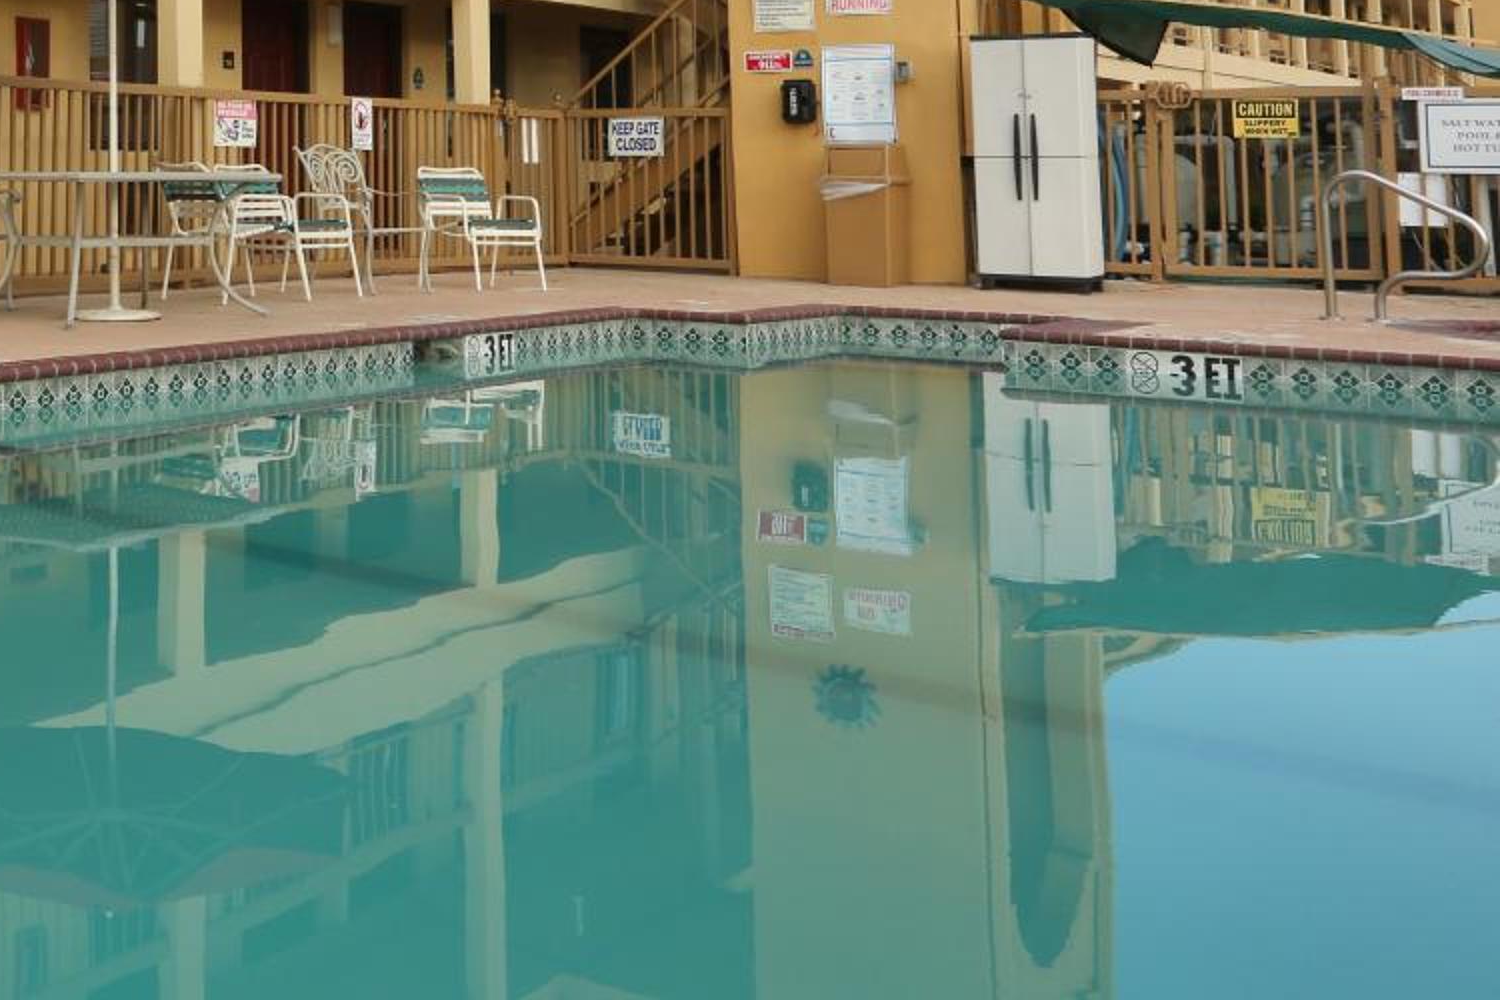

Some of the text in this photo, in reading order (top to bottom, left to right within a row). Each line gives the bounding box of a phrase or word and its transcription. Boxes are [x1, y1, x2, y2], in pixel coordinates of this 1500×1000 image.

[1239, 103, 1293, 116] CAUTION
[612, 121, 659, 135] KEEP GATE
[1243, 119, 1286, 127] SLIPPERY
[1244, 127, 1288, 135] WHEN WET
[1457, 131, 1490, 139] POOL
[616, 137, 657, 151] CLOSED
[1453, 143, 1479, 152] HOT
[1170, 355, 1196, 378] 3
